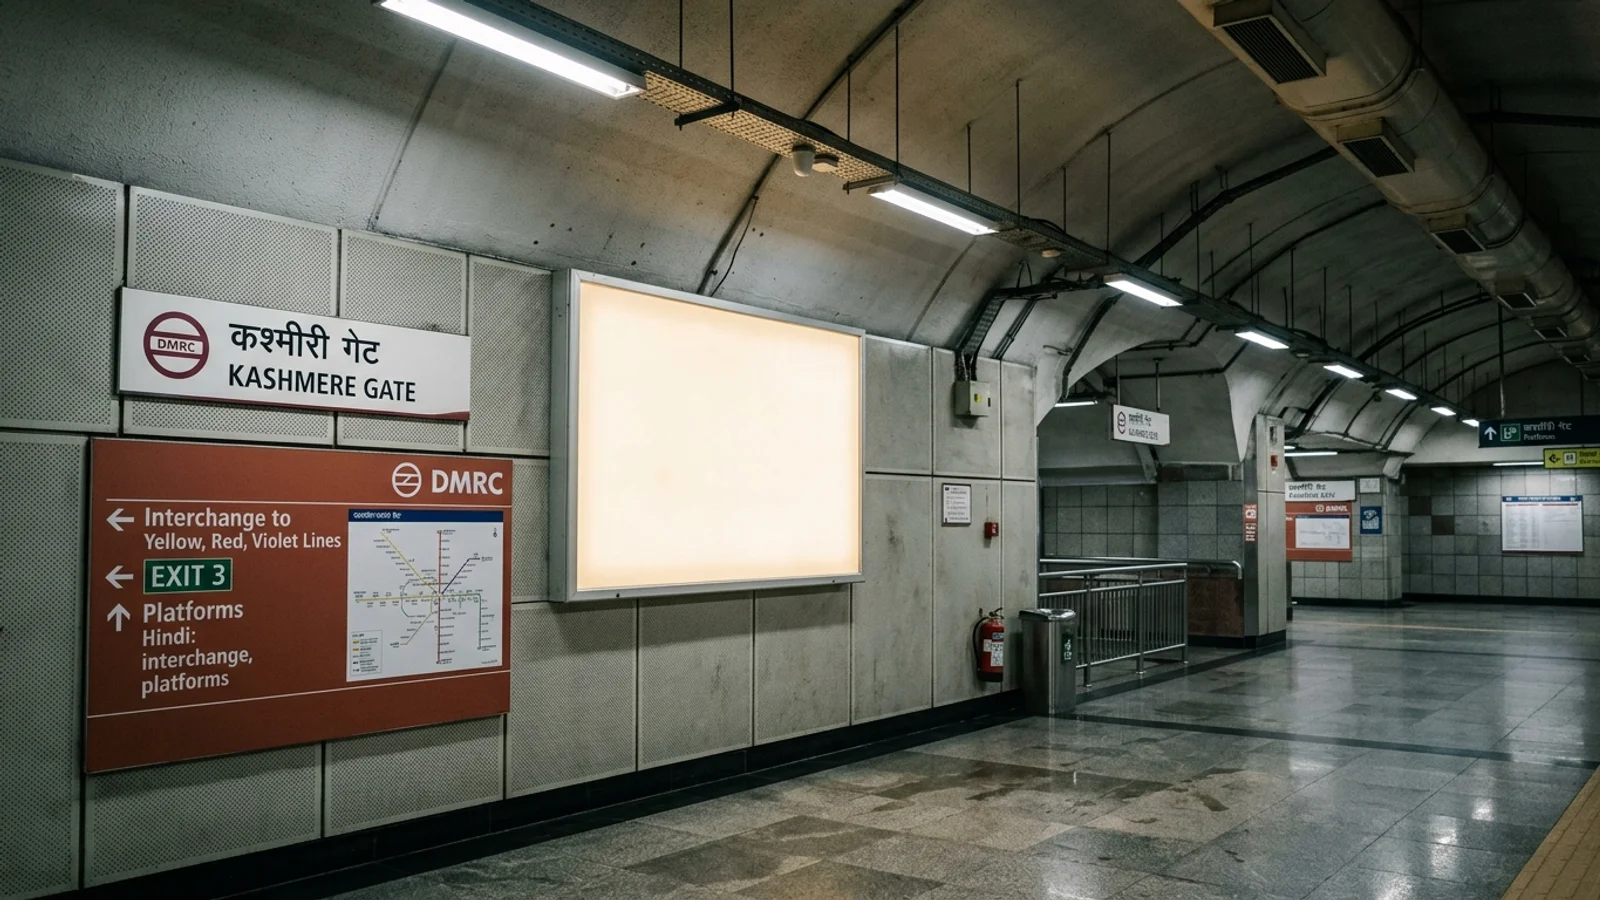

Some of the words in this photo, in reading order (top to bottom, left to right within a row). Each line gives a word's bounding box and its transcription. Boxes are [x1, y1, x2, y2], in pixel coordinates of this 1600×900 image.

[157, 338, 195, 354] DMRC
[229, 320, 330, 360] कश्मीरी
[342, 328, 381, 365] गेट
[229, 363, 357, 398] KASHMERE
[364, 378, 416, 402] GATE
[431, 469, 504, 496] DMRC
[144, 507, 266, 531] Interchange
[271, 510, 292, 527] to
[144, 532, 206, 552] Yellow,
[211, 532, 248, 551] Red,
[252, 533, 298, 549] Violet
[303, 532, 341, 549] Lines
[151, 564, 204, 588] EXIT
[212, 564, 226, 586] 3
[143, 600, 244, 624] Platforms
[142, 627, 196, 647] Hindi:
[142, 648, 253, 671] interchange,
[141, 672, 230, 699] platforms
